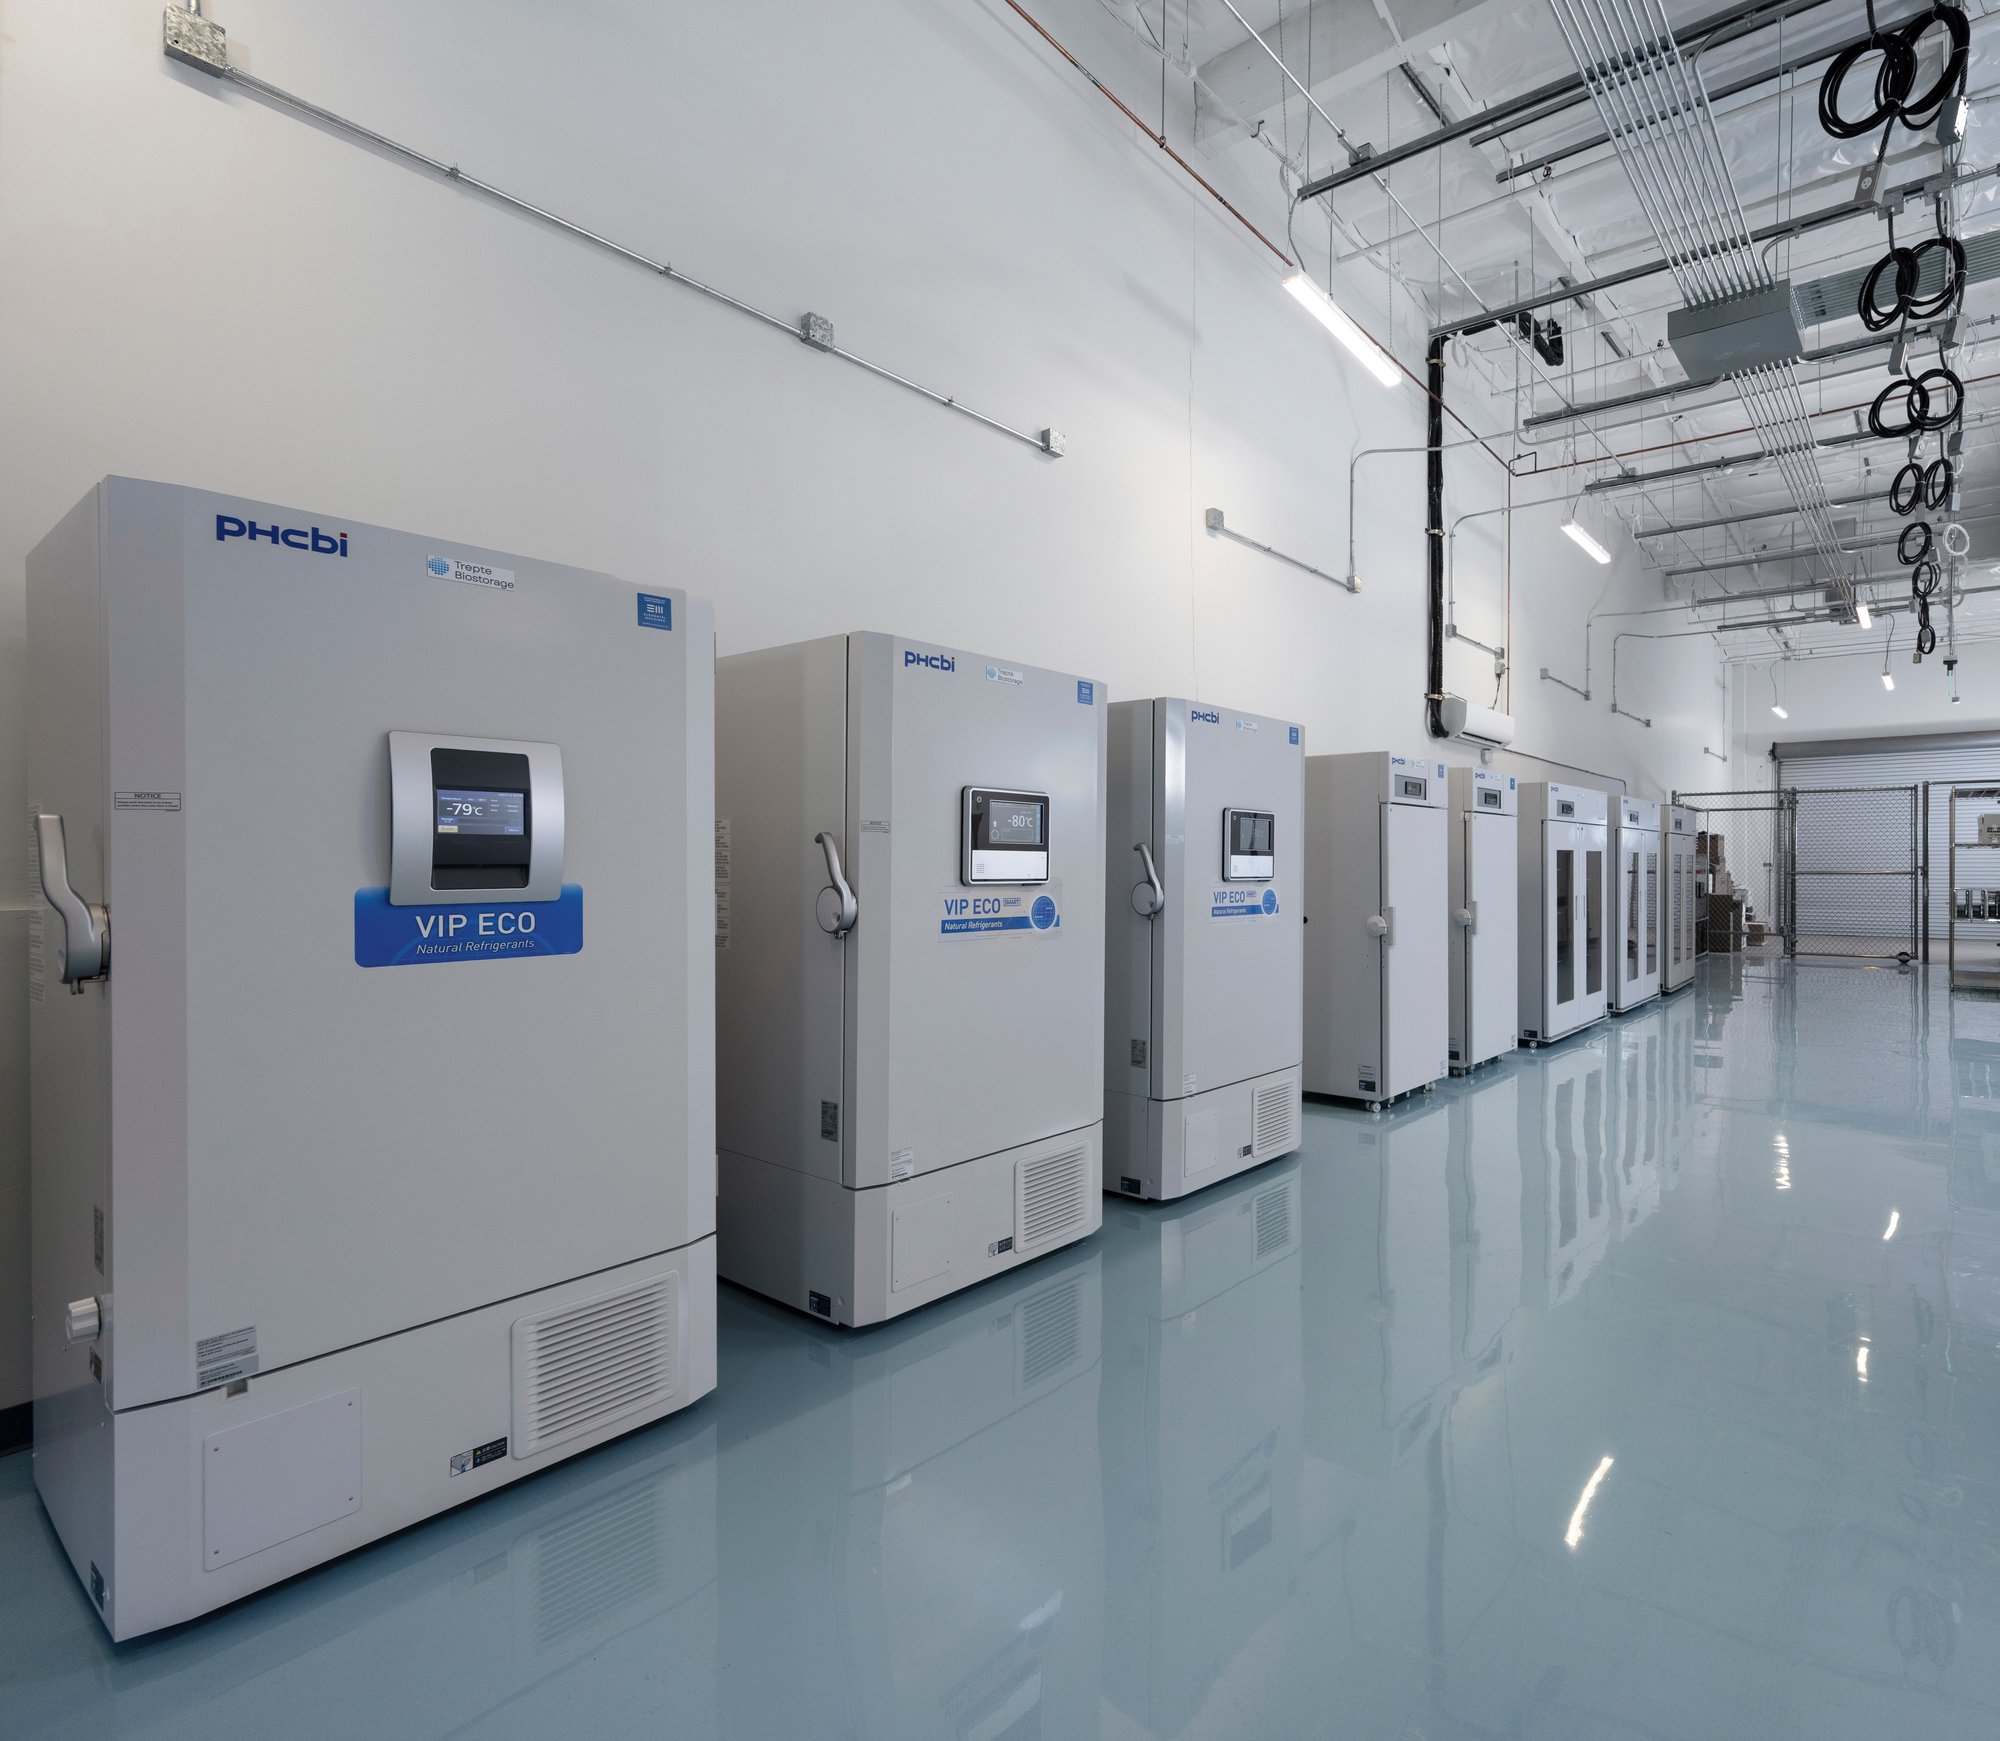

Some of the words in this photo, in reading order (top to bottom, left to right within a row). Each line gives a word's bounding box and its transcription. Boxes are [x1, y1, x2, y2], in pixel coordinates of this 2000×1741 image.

[454, 560, 493, 575] Trepte
[454, 570, 515, 589] Biostorage
[1213, 891, 1228, 904] VIP
[1229, 890, 1246, 904] ECO
[944, 898, 969, 916] VIP
[973, 898, 1001, 915] ECO
[415, 914, 468, 938] VIP
[478, 911, 536, 935] ECO
[944, 921, 967, 931] Natural
[967, 920, 1003, 931] Refrigerants
[416, 942, 463, 955] Natural
[465, 939, 535, 953] Refrigerants
